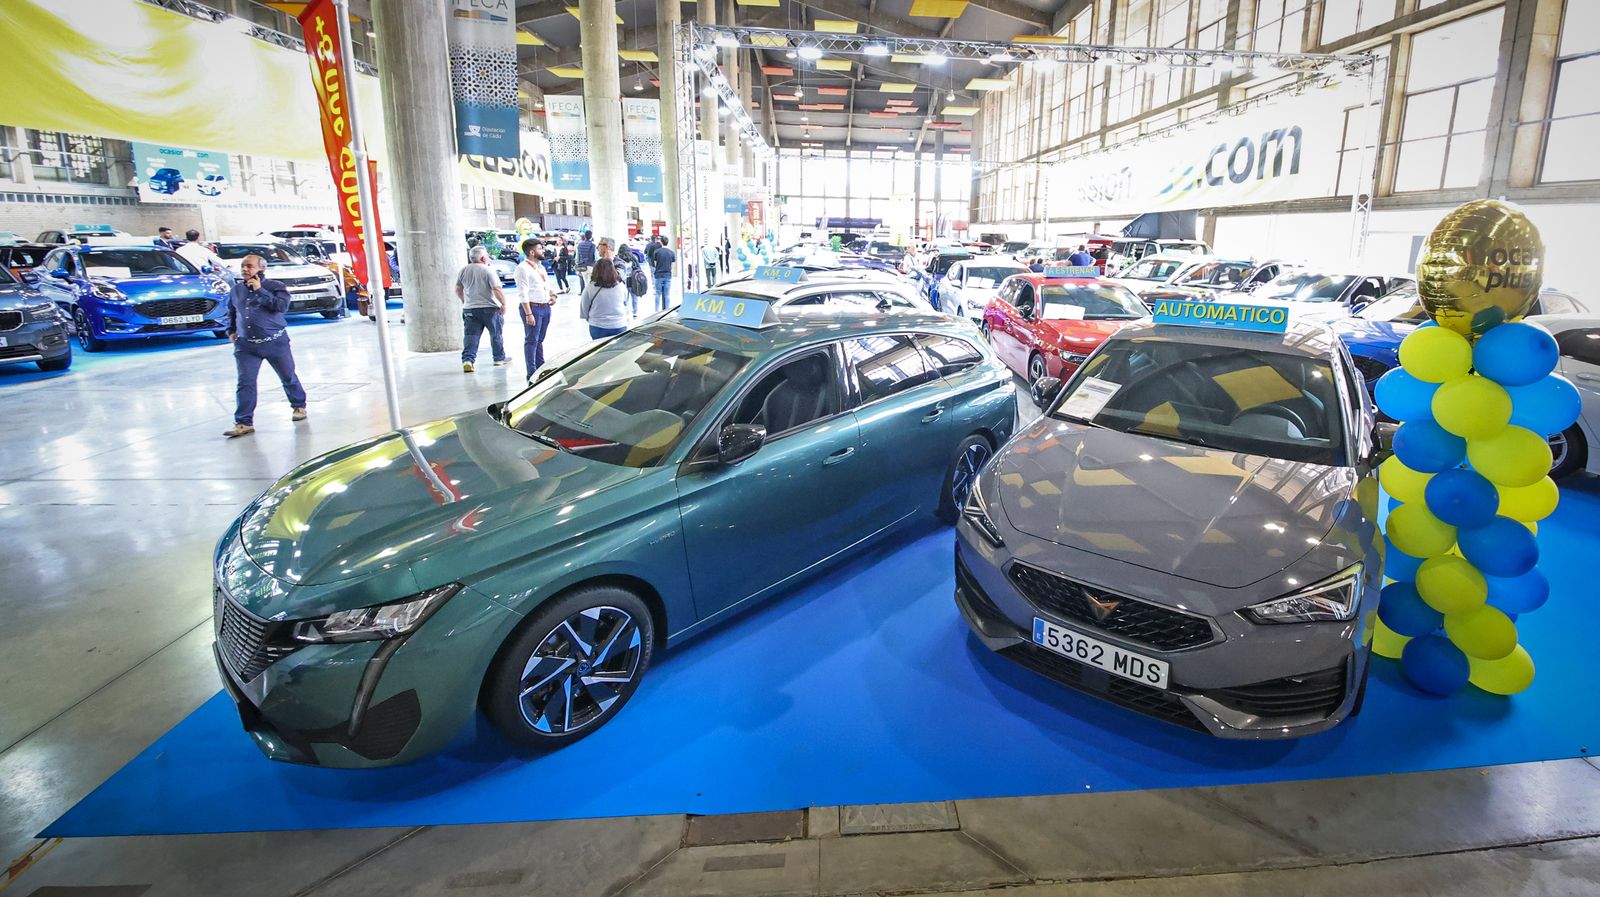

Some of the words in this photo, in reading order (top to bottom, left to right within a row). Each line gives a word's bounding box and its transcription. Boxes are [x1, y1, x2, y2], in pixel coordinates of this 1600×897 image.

[548, 102, 581, 111] IFECA
[626, 105, 657, 114] IFECA
[784, 270, 791, 278] 0
[1056, 266, 1096, 275] ESTRENAR
[695, 298, 728, 315] KM.
[733, 302, 746, 317] 0
[1155, 301, 1287, 325] AUTOMATICO
[1047, 626, 1105, 666] 5362
[1113, 651, 1161, 684] MDS
